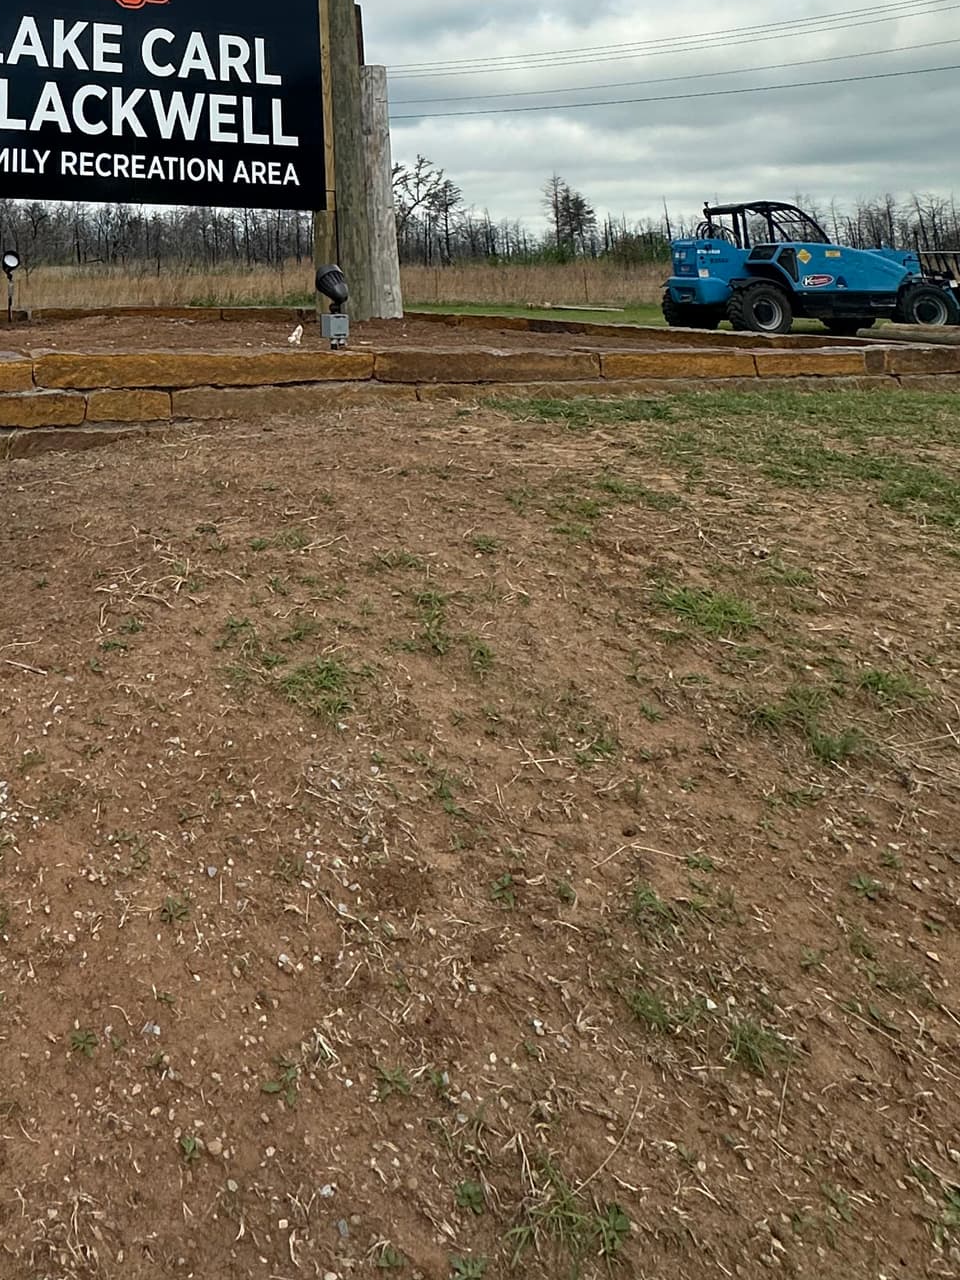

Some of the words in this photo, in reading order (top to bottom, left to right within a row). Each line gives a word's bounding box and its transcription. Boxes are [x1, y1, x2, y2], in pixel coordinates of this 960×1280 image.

[141, 28, 282, 86] CARL
[60, 150, 224, 183] RECREATION
[232, 160, 301, 186] AREA
